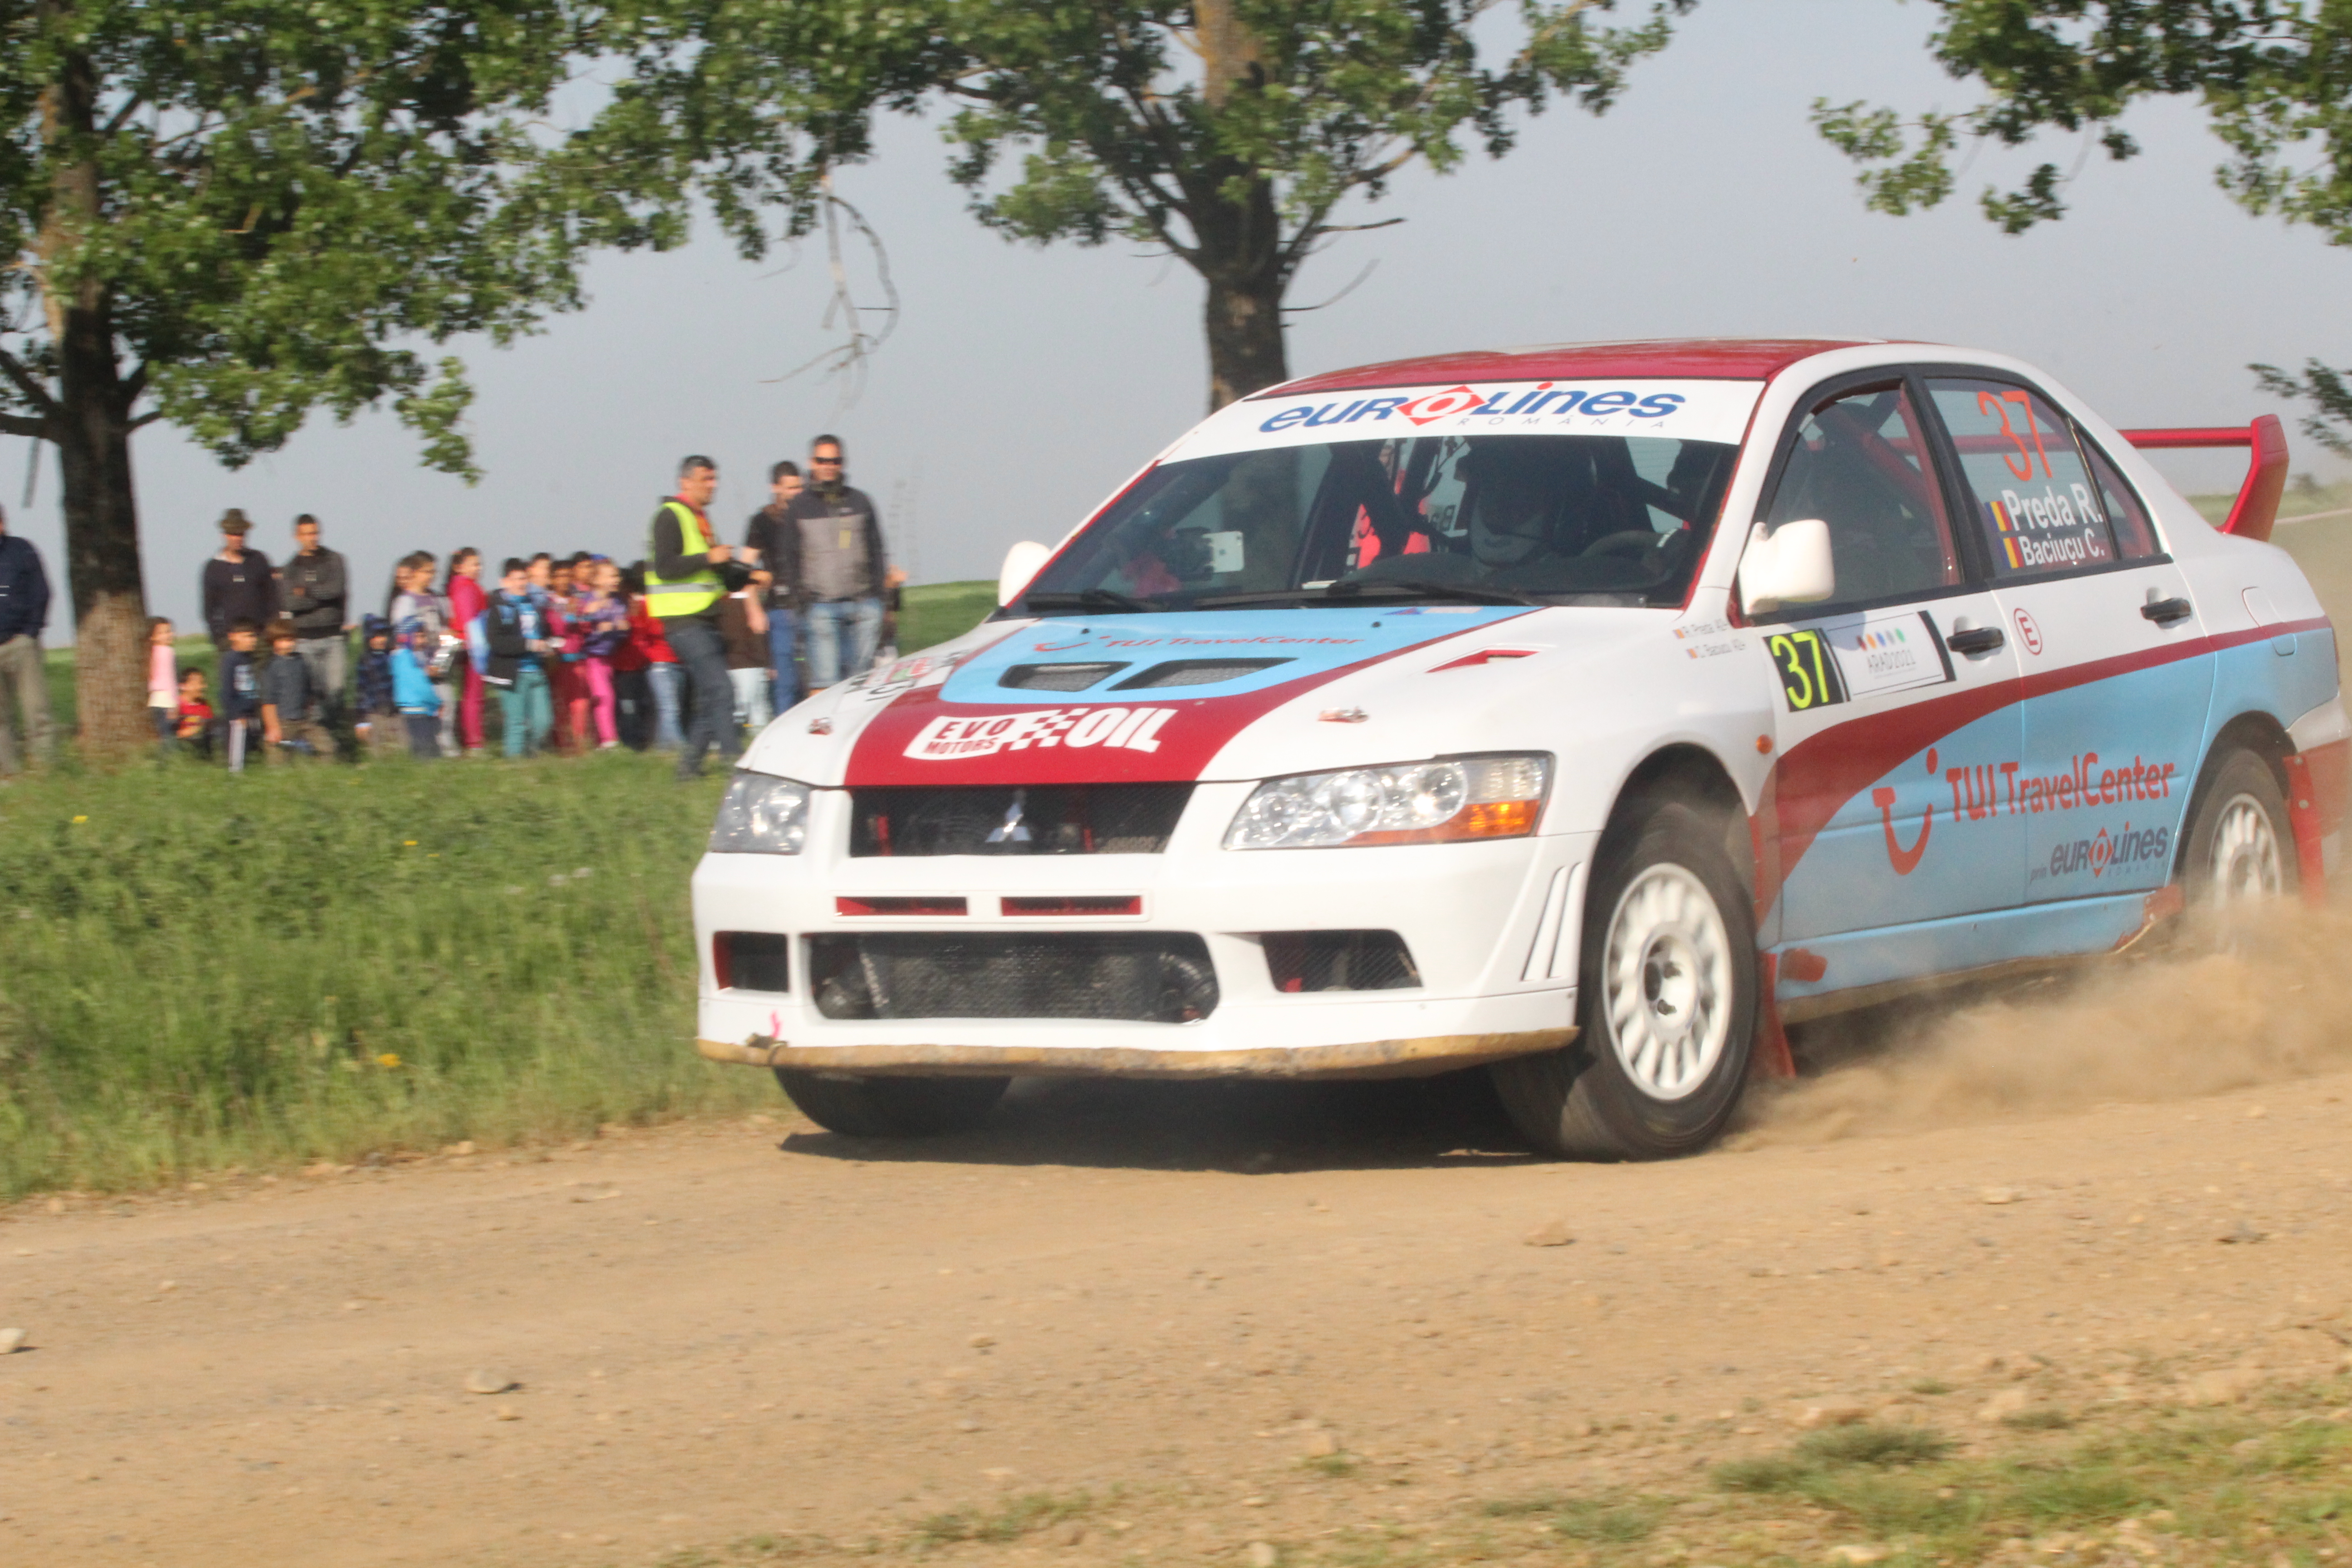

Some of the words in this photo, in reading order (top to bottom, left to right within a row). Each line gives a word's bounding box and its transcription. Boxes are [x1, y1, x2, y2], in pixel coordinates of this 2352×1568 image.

[1977, 390, 2053, 481] 37
[2001, 485, 2076, 532] Preda
[2070, 483, 2103, 524] R.
[2018, 532, 2086, 567] Baciucu
[2084, 527, 2105, 558] C.
[1105, 639, 1163, 647] TUI
[2018, 617, 2038, 647] E
[1769, 629, 1829, 710] 37
[921, 737, 1000, 754] MOTORS
[932, 717, 1016, 740] EVO
[1063, 707, 1179, 753] OIL
[1946, 764, 1997, 822] TUI
